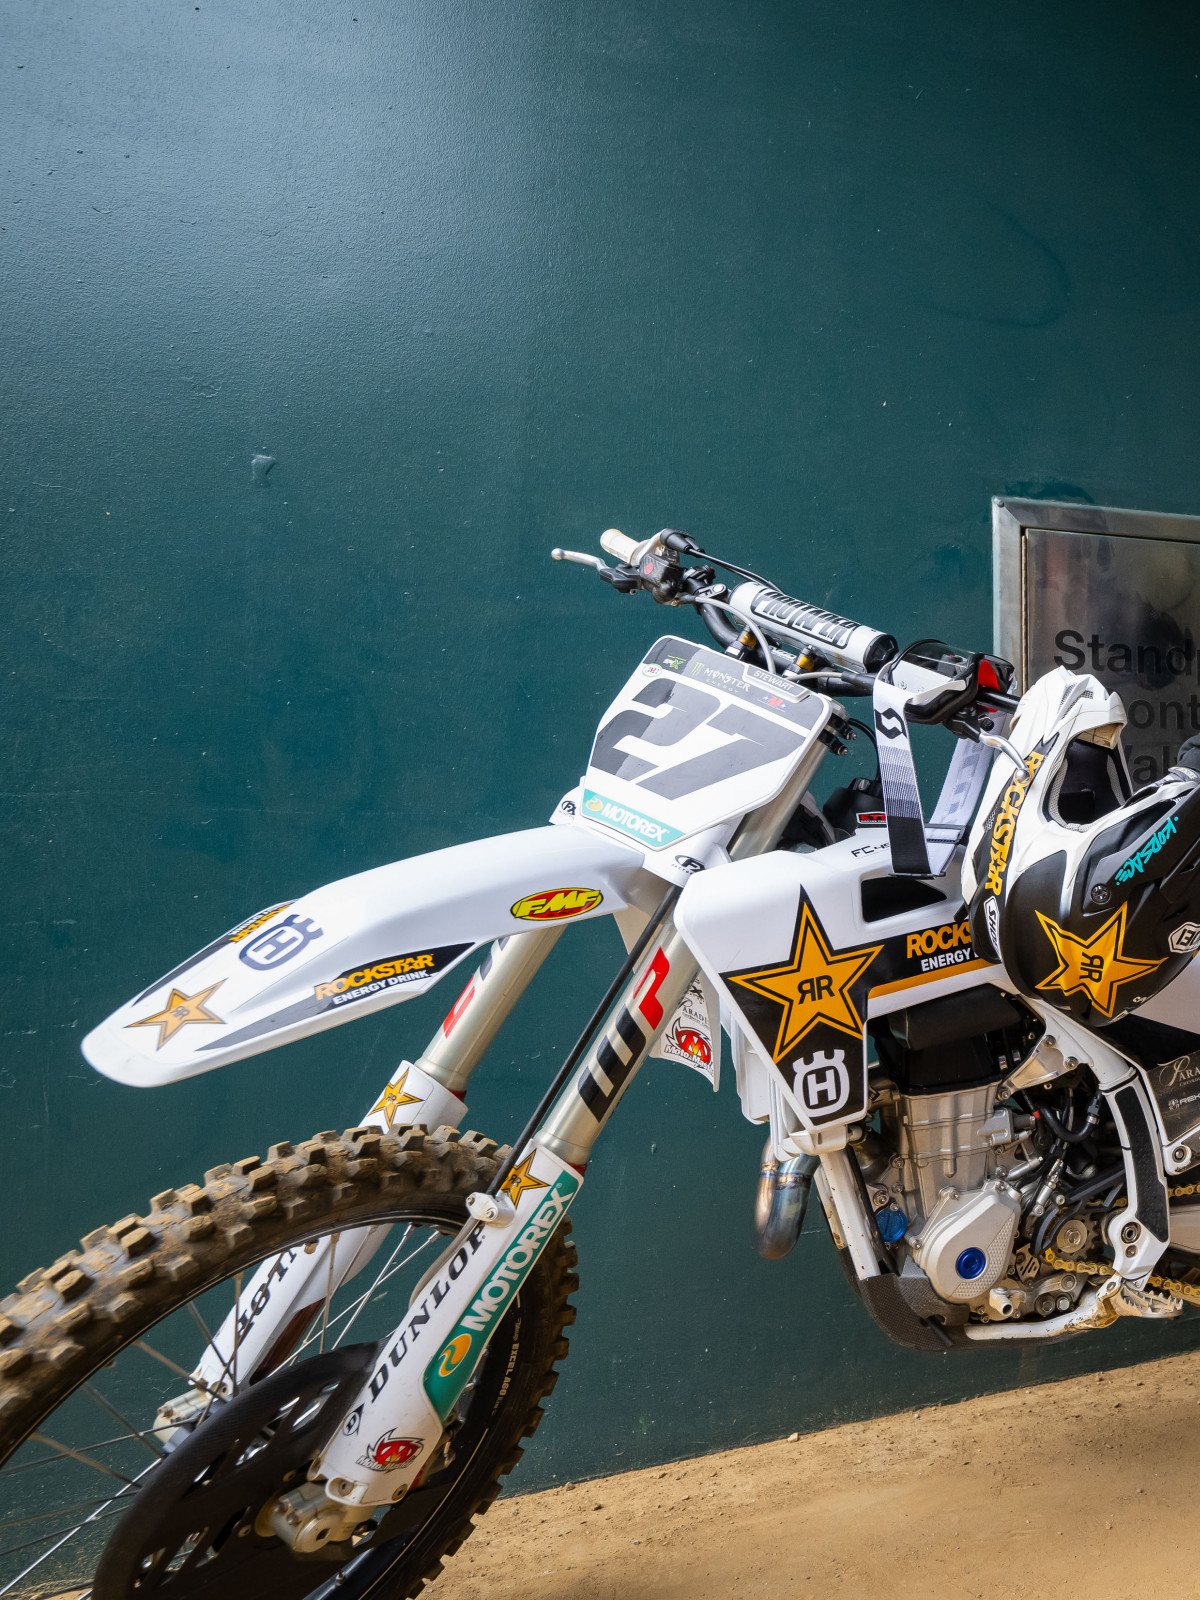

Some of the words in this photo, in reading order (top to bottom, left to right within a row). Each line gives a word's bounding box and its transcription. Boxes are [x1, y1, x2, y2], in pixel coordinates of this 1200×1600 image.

[753, 669, 796, 692] STEWART
[590, 676, 806, 800] 27
[601, 801, 668, 843] MOTOREX
[985, 750, 1044, 895] ROCKSTAR
[851, 845, 875, 858] FC
[514, 888, 603, 918] FMF
[314, 953, 435, 1001] ROCKSTAR
[921, 948, 971, 973] ENERGY
[333, 980, 387, 1005] ENERGY
[387, 970, 430, 986] DRINK
[462, 1188, 574, 1332] MOTOREX
[368, 1225, 486, 1404] DUNLOP
[505, 1343, 519, 1376] EXCEL
